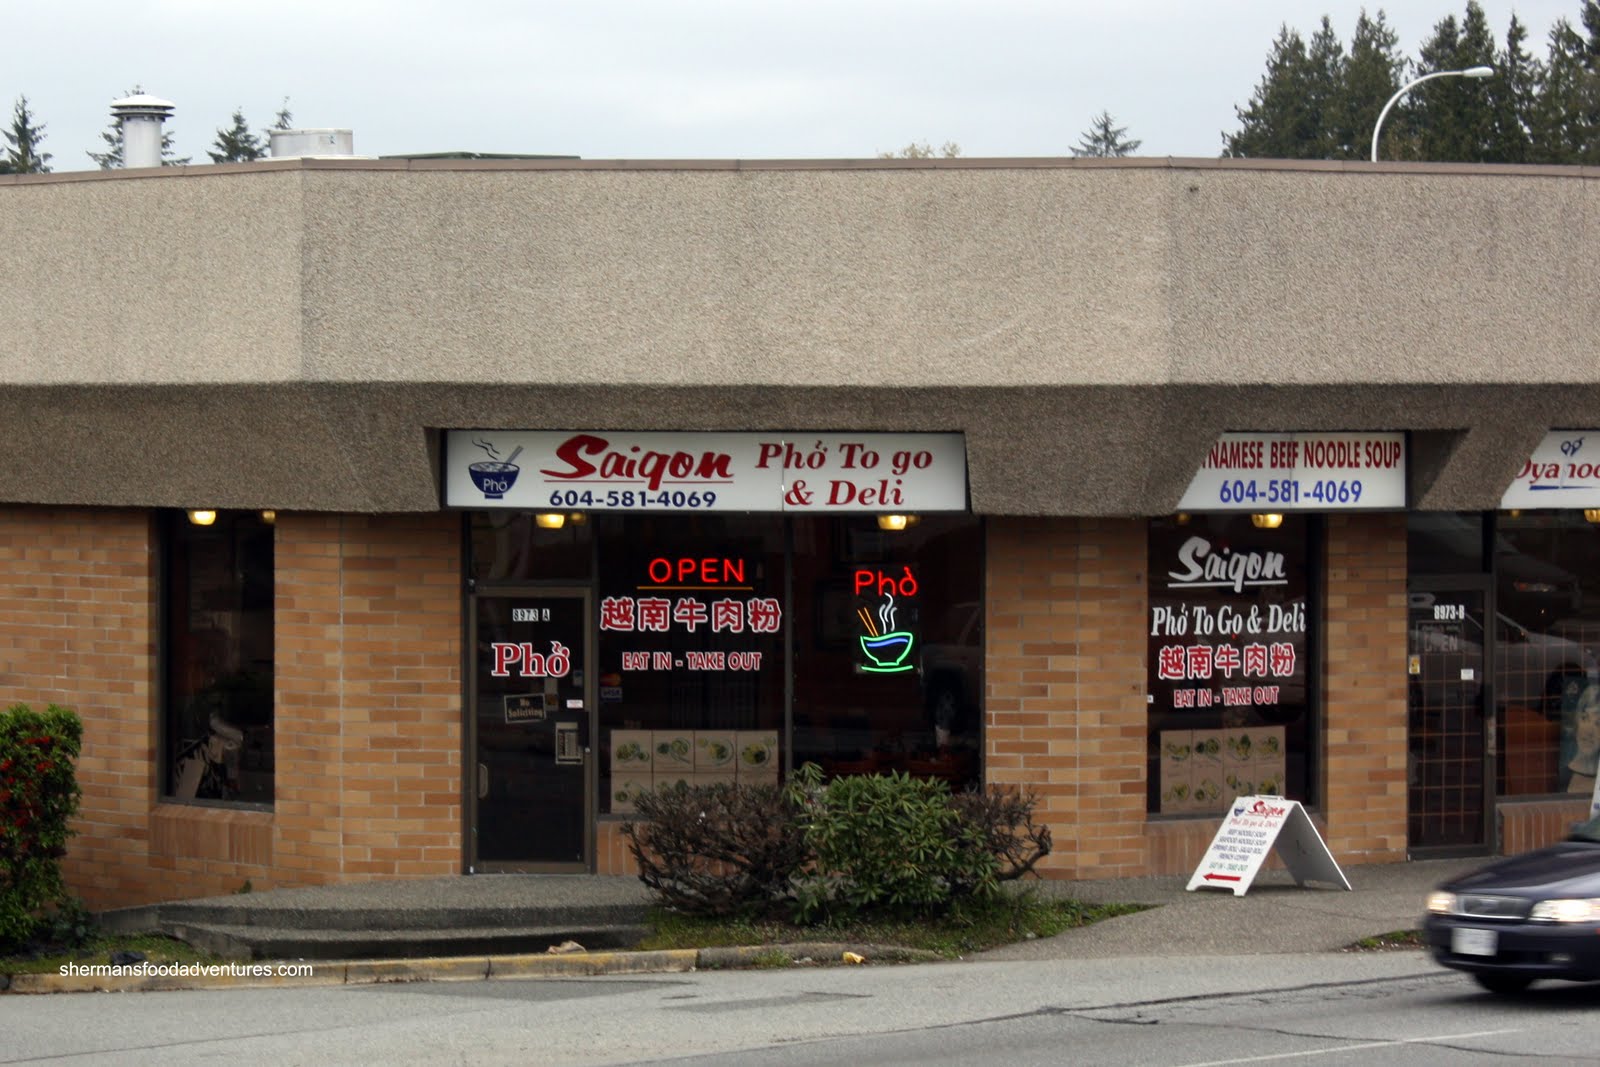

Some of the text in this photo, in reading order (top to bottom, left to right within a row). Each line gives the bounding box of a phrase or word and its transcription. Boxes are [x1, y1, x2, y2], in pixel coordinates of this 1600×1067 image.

[540, 434, 734, 490] Saigon
[755, 440, 933, 475] Phở To go
[1270, 441, 1299, 469] BEEF
[1304, 441, 1361, 468] NOODLE
[1365, 441, 1401, 468] SOUP
[550, 490, 716, 508] 604-581-4069
[784, 479, 904, 506] & Deli
[1219, 480, 1362, 503] 604-581-4069
[649, 558, 745, 583] OPEN
[1168, 536, 1286, 593] Saigon
[600, 597, 782, 633] 越南牛肉粉
[1193, 606, 1214, 636] To
[1217, 605, 1243, 636] Go
[1247, 604, 1263, 634] &
[1267, 603, 1306, 633] Deli
[491, 641, 570, 678] Phở
[622, 652, 651, 670] EAT
[653, 652, 672, 670] IN
[685, 652, 725, 670] TAKE
[728, 652, 762, 670] OUT
[1158, 643, 1296, 679] 越南牛肉粉
[1174, 689, 1195, 708] EAT
[1197, 688, 1212, 706] IN
[1222, 687, 1251, 706] TAKE
[1254, 686, 1279, 704] OUT
